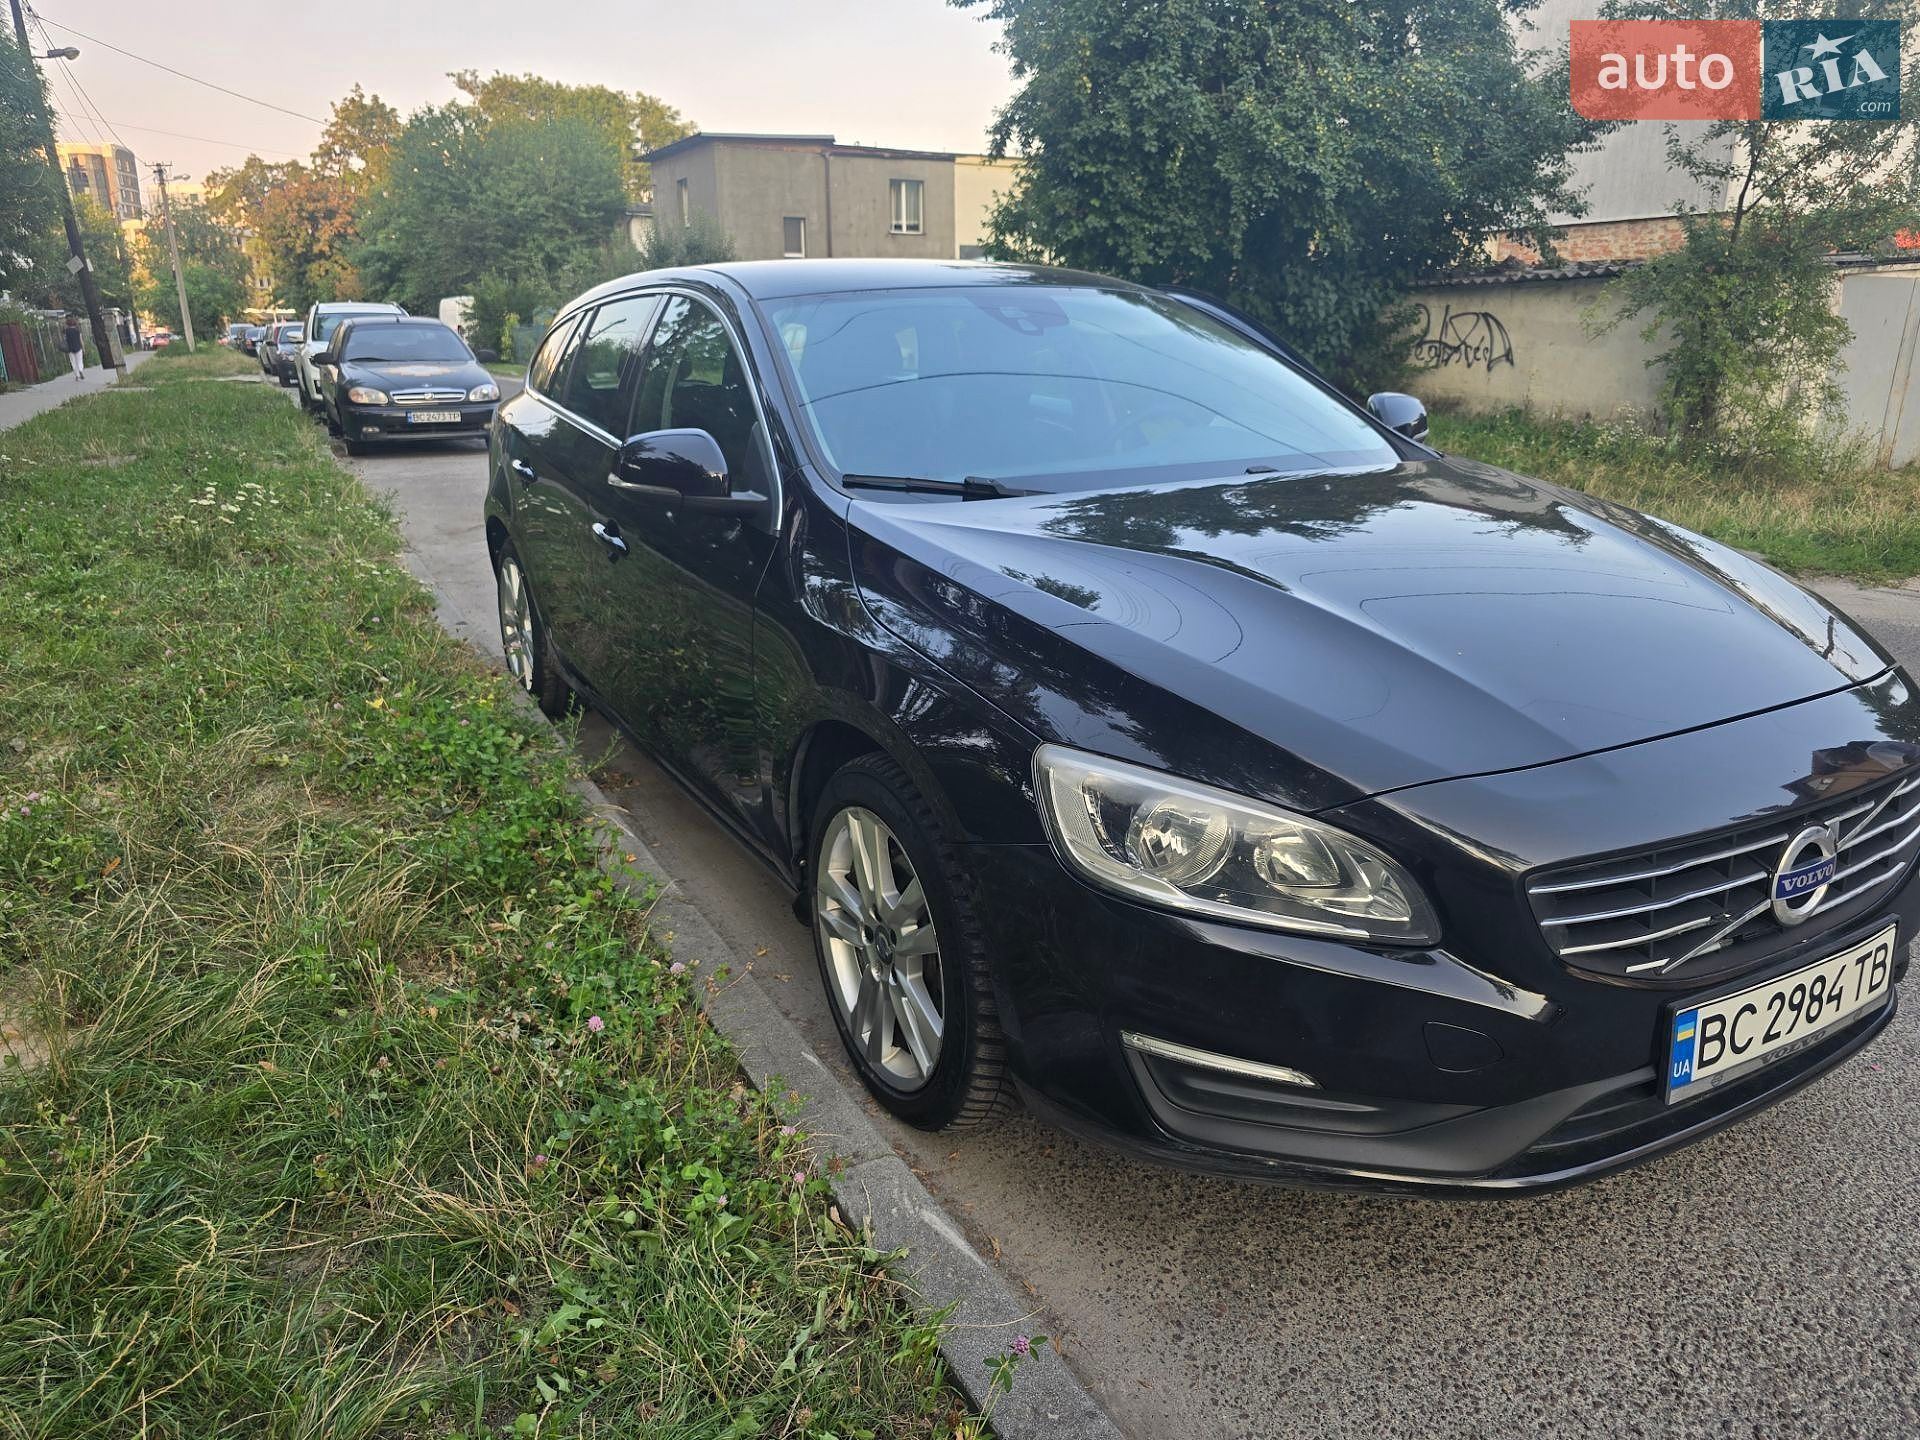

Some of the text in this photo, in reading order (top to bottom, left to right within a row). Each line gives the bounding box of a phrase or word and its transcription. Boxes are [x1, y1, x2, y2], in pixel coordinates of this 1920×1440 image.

[413, 412, 425, 421] BC
[1781, 862, 1835, 893] VOLVO
[1697, 942, 1889, 1069] BC 2984 TB
[1760, 1030, 1826, 1064] VOLVO
[1673, 1061, 1690, 1078] UA
